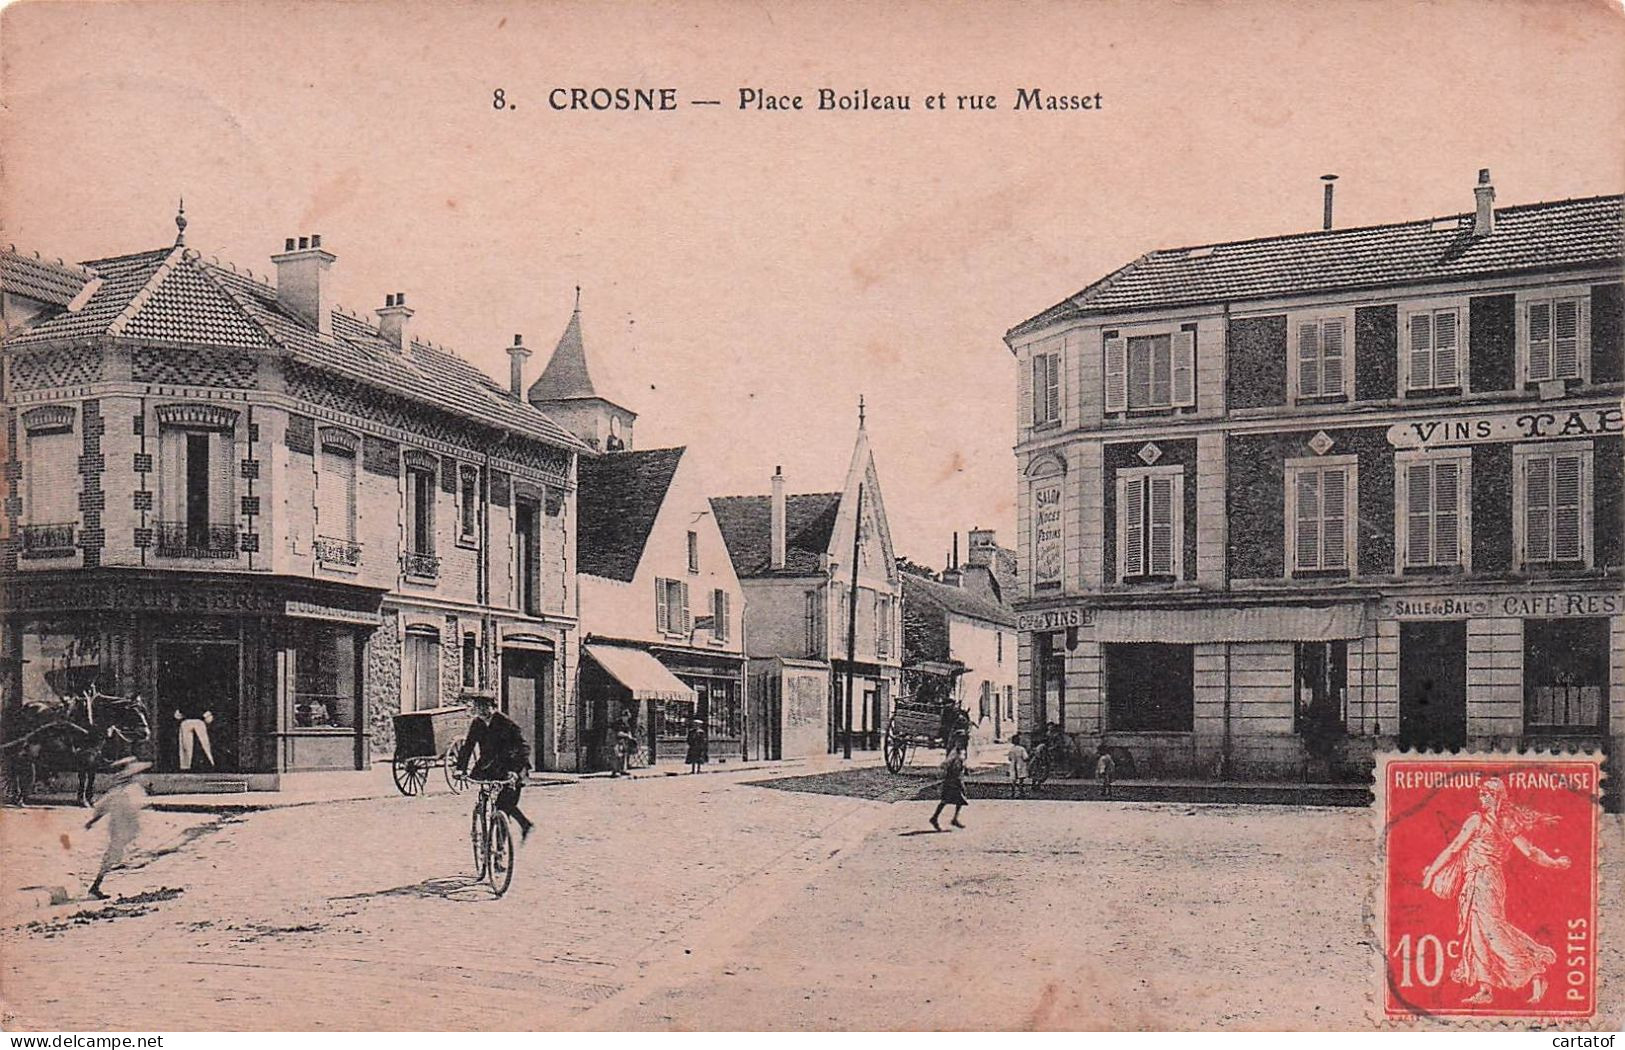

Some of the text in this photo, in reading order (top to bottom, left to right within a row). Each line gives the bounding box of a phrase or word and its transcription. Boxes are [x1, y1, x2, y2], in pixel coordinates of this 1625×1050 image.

[493, 87, 1103, 111] 8. CROSNE Place Boileau et rue Masset
[1411, 421, 1492, 442] VINS
[1037, 489, 1060, 508] SALON
[1395, 600, 1431, 616] SALLE
[1442, 599, 1470, 616] BAL
[1563, 594, 1625, 615] RES
[1043, 609, 1078, 628] VINS
[1508, 771, 1590, 791] FRANÇAISE
[1567, 918, 1587, 1001] POSTES
